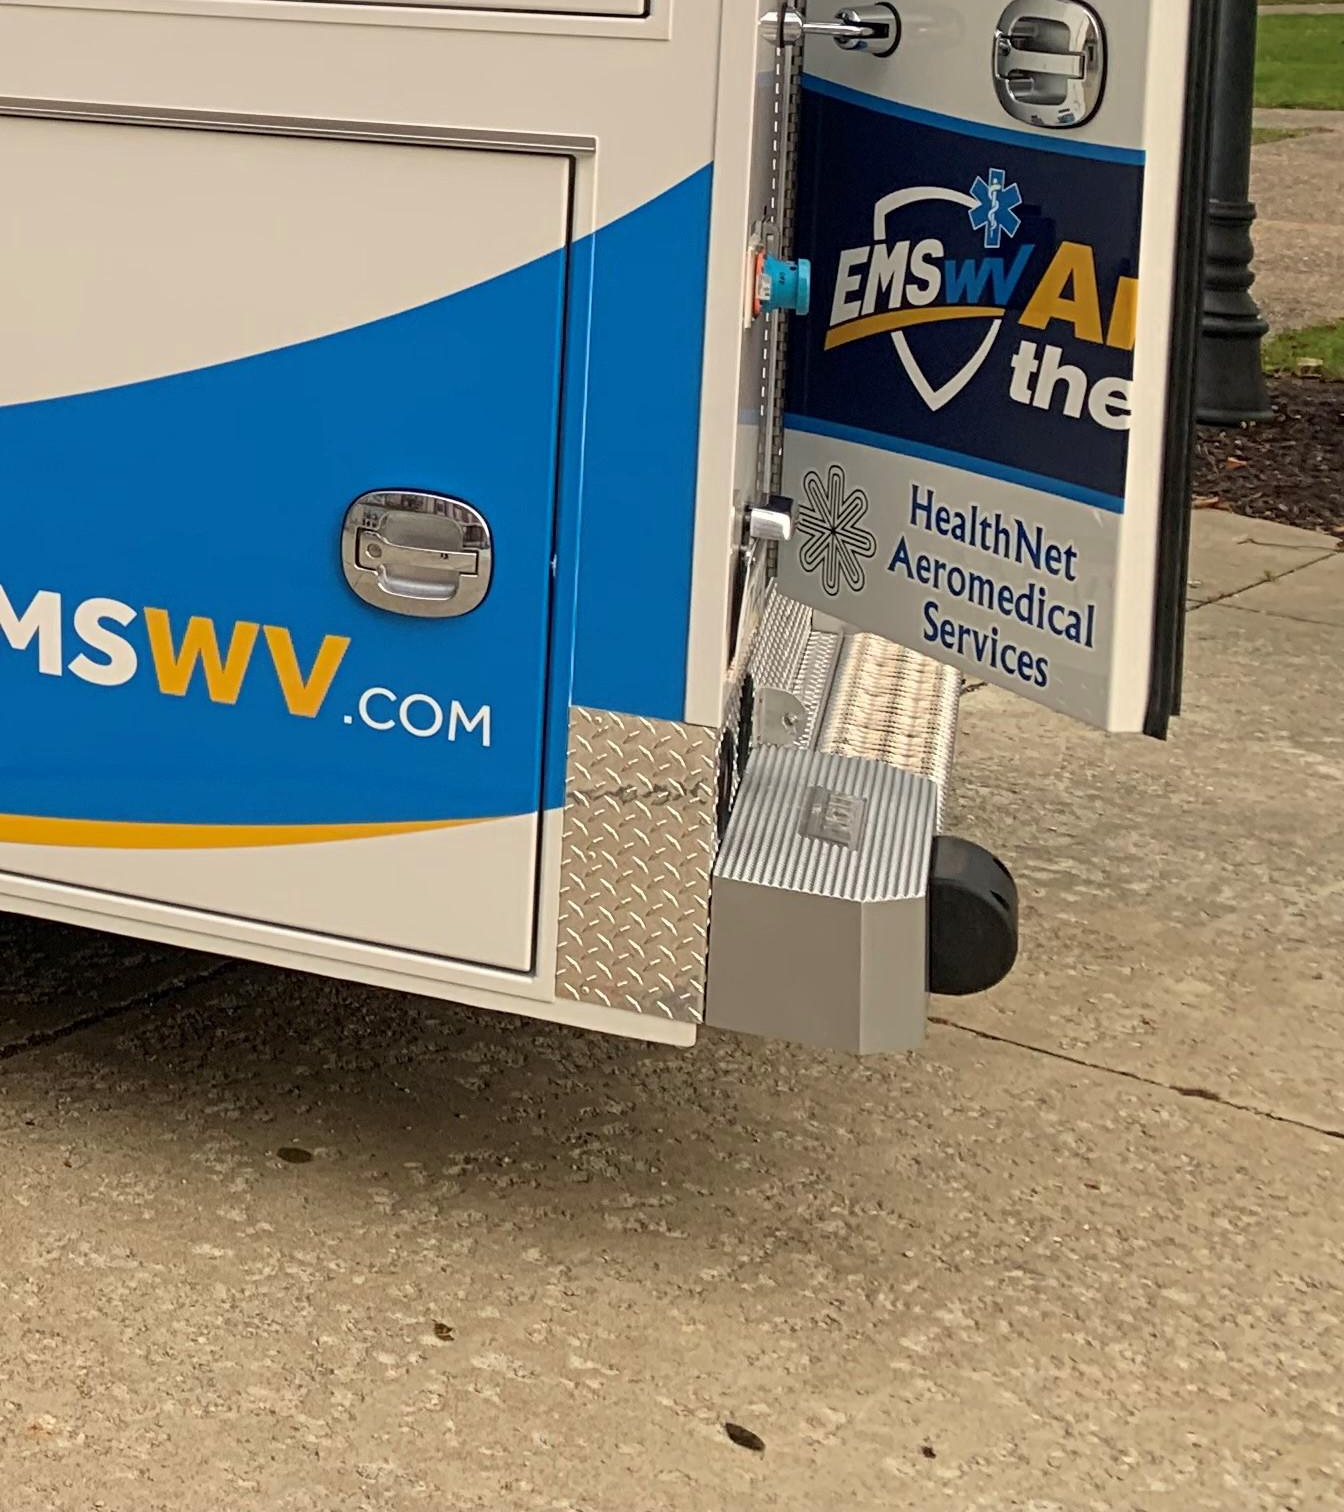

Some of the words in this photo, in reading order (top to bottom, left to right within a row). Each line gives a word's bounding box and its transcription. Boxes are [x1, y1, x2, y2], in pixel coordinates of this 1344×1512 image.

[1009, 340, 1134, 431] the
[910, 484, 1078, 582] HealthNet
[887, 536, 1095, 649] Aeromedical
[923, 600, 1049, 688] Services
